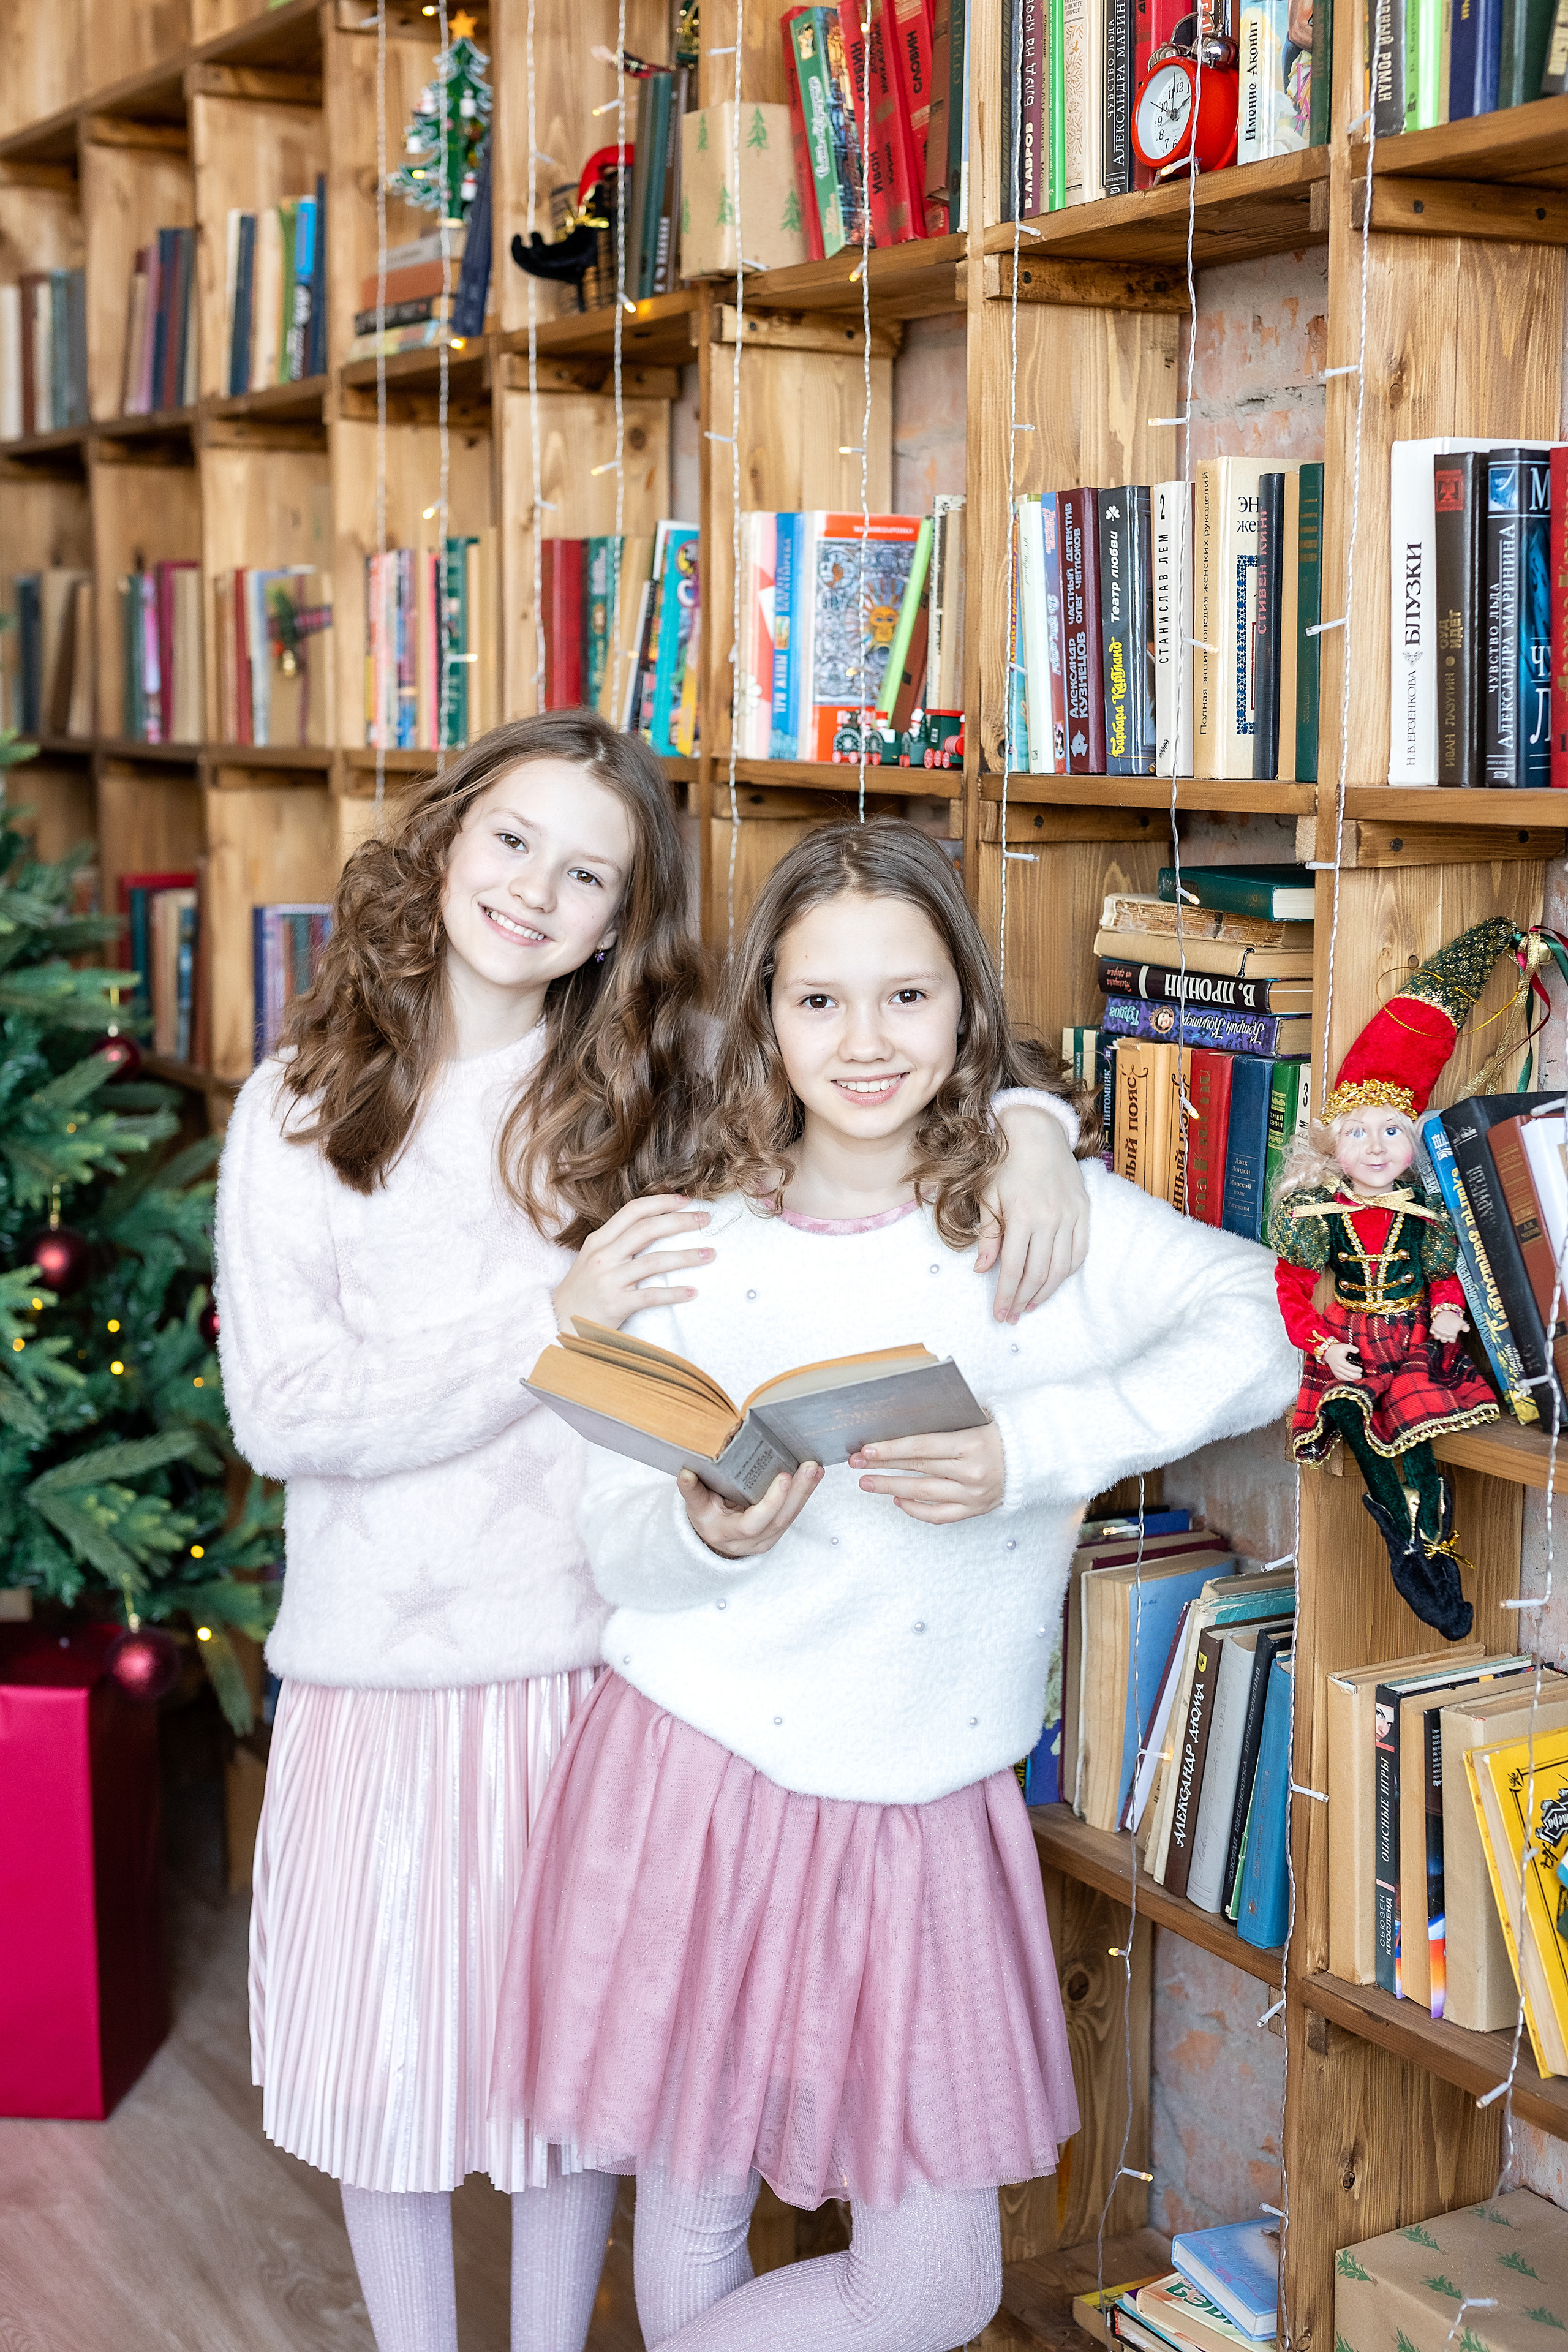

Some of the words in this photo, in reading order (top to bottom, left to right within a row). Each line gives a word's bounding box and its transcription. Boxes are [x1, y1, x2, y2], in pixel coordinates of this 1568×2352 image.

[907, 29, 923, 94] СЛОВИН
[1246, 20, 1259, 77] Аконит
[1168, 89, 1175, 99] 11
[1177, 81, 1183, 94] 12
[1378, 51, 1392, 102] РОМАН
[1112, 64, 1126, 167] АЛЕКСАНДРА
[1158, 116, 1163, 127] 9
[1161, 100, 1168, 113] 10
[1245, 82, 1258, 141] Имение
[1159, 129, 1164, 140] 8
[1164, 138, 1169, 149] 7
[1172, 139, 1178, 149] 6
[1200, 471, 1211, 537] рукоделий
[1064, 502, 1074, 562] ДЕТЕКТИВ
[1109, 530, 1120, 578] любви
[1158, 533, 1169, 565] ЛЕМ
[1259, 505, 1268, 556] КИНГ
[1073, 527, 1083, 589] ЧЕГЛОКОВ
[1498, 523, 1516, 628] МАРИНИНА
[1065, 568, 1076, 625] ЧАСТНЫЙ
[1074, 594, 1084, 624] ОЛЕГ
[1110, 581, 1121, 624] Театр
[1158, 573, 1169, 664] СТАНИСЛАВ
[1257, 558, 1268, 635] СТИВЕН
[1404, 542, 1422, 646] БЛУЗКИ
[1488, 582, 1501, 619] ЛЬДА
[1449, 609, 1464, 649] ИДЕТ
[1076, 631, 1088, 718] КУЗНЕЦОВ
[1109, 636, 1128, 704] Картланд
[1488, 625, 1499, 693] ЧУВСТВО
[1199, 688, 1209, 735] Полная
[1444, 673, 1456, 726] ЛАЗУТИН
[1496, 636, 1517, 750] АЛЕКСАНДРА
[1110, 704, 1128, 758] Барбара
[1445, 734, 1456, 767] ИВАН
[1164, 973, 1236, 1005] ПРОНИН
[1237, 982, 1256, 1007] В.
[1109, 1005, 1140, 1027] Герцог
[1182, 1011, 1226, 1041] Коултер
[1225, 1019, 1265, 1046] Кэтрин
[1102, 1069, 1111, 1126] ПИТОМНИК
[1229, 1178, 1251, 1189] Морской
[1231, 1165, 1251, 1175] Лондон
[1234, 1157, 1248, 1166] Джек
[1174, 1742, 1195, 1848] АЛЕКСАНДР
[1188, 1682, 1205, 1743] ДЮМА
[1381, 1756, 1389, 1796] ИГРЫ
[1227, 1836, 1238, 1887] ЗОЛОТАЯ
[1233, 1760, 1248, 1834] БИБЛИОТЕКА
[1381, 1797, 1389, 1863] ОПАСНЫЕ
